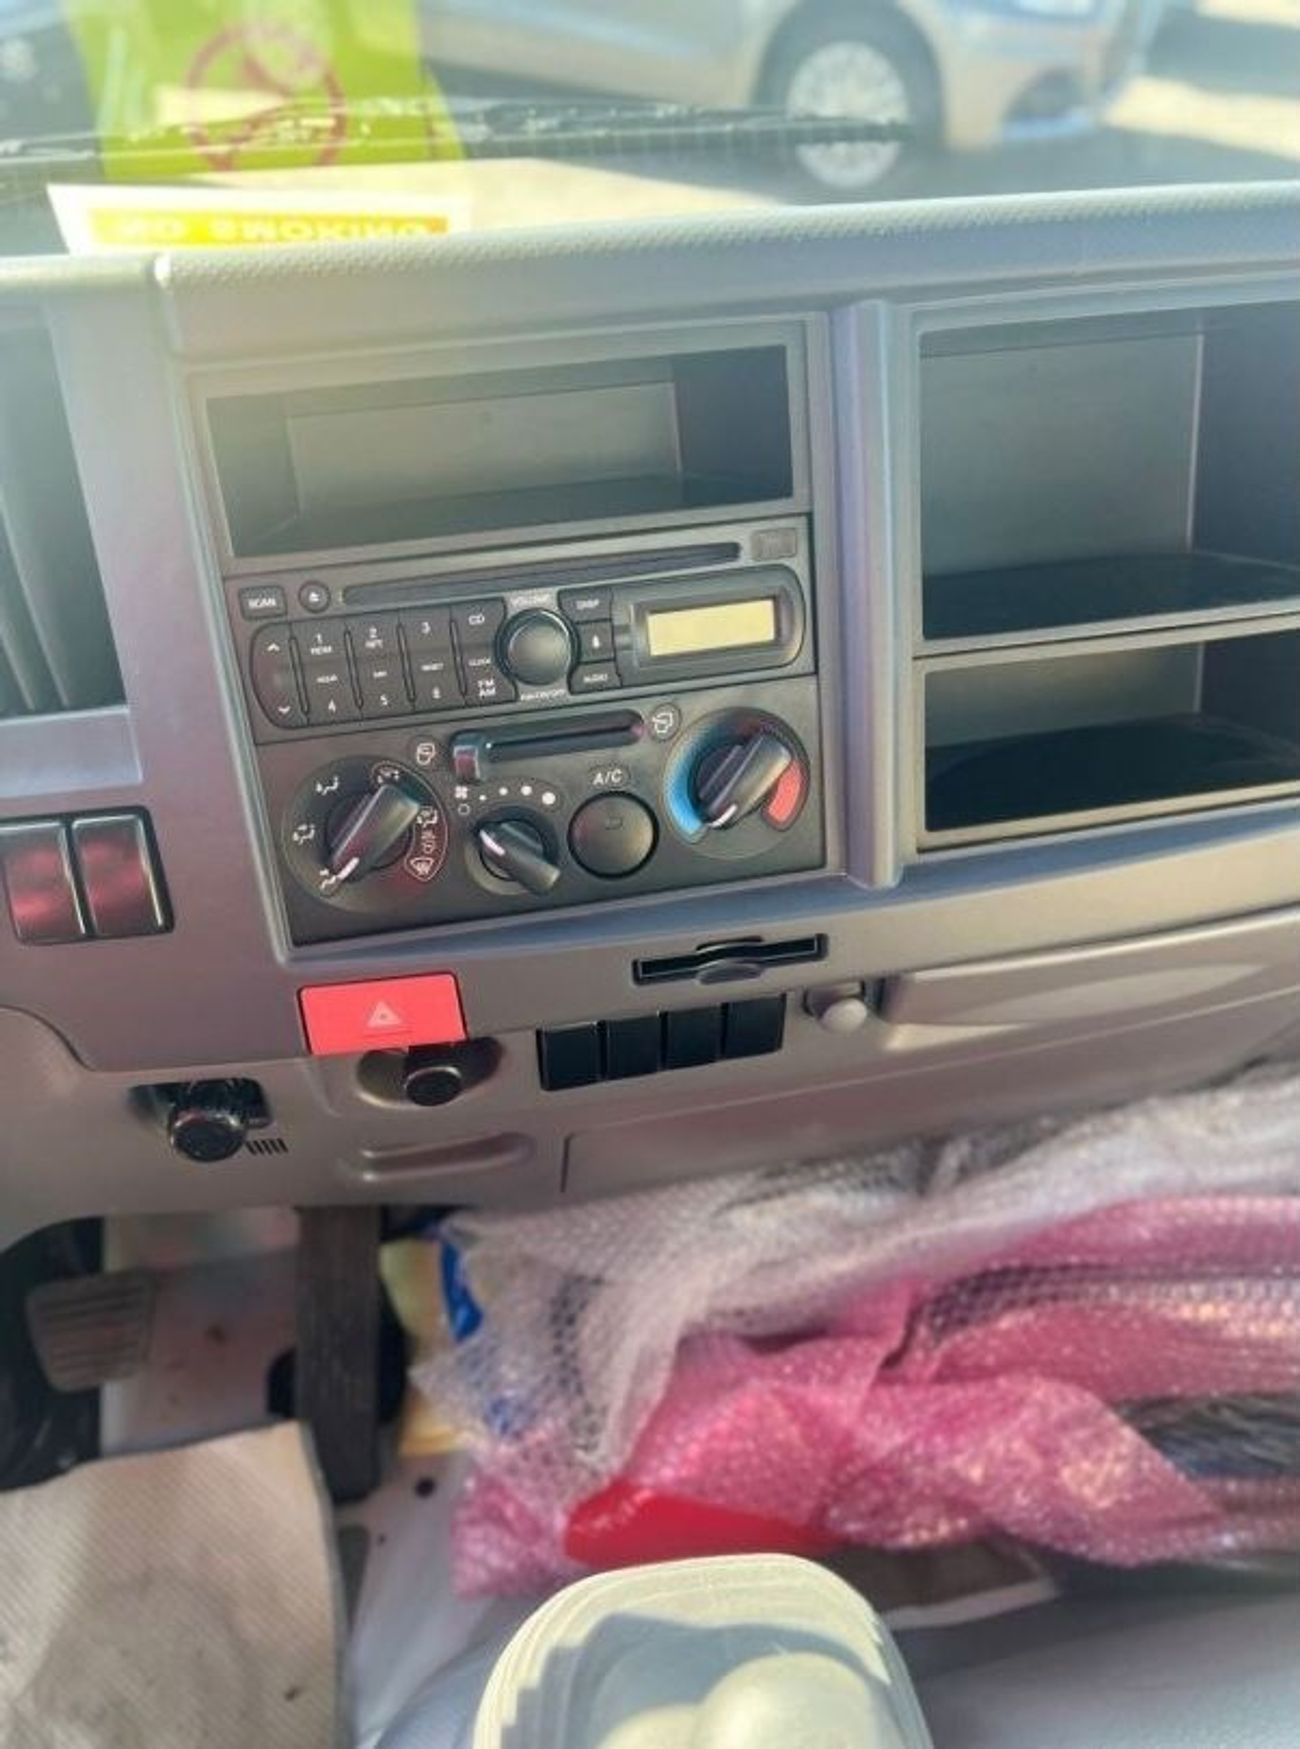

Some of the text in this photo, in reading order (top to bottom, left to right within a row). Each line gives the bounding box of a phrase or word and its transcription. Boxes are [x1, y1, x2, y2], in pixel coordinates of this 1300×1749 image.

[468, 613, 486, 626] CD
[421, 621, 431, 635] 3
[479, 687, 497, 698] AM
[592, 768, 623, 786] A/C
